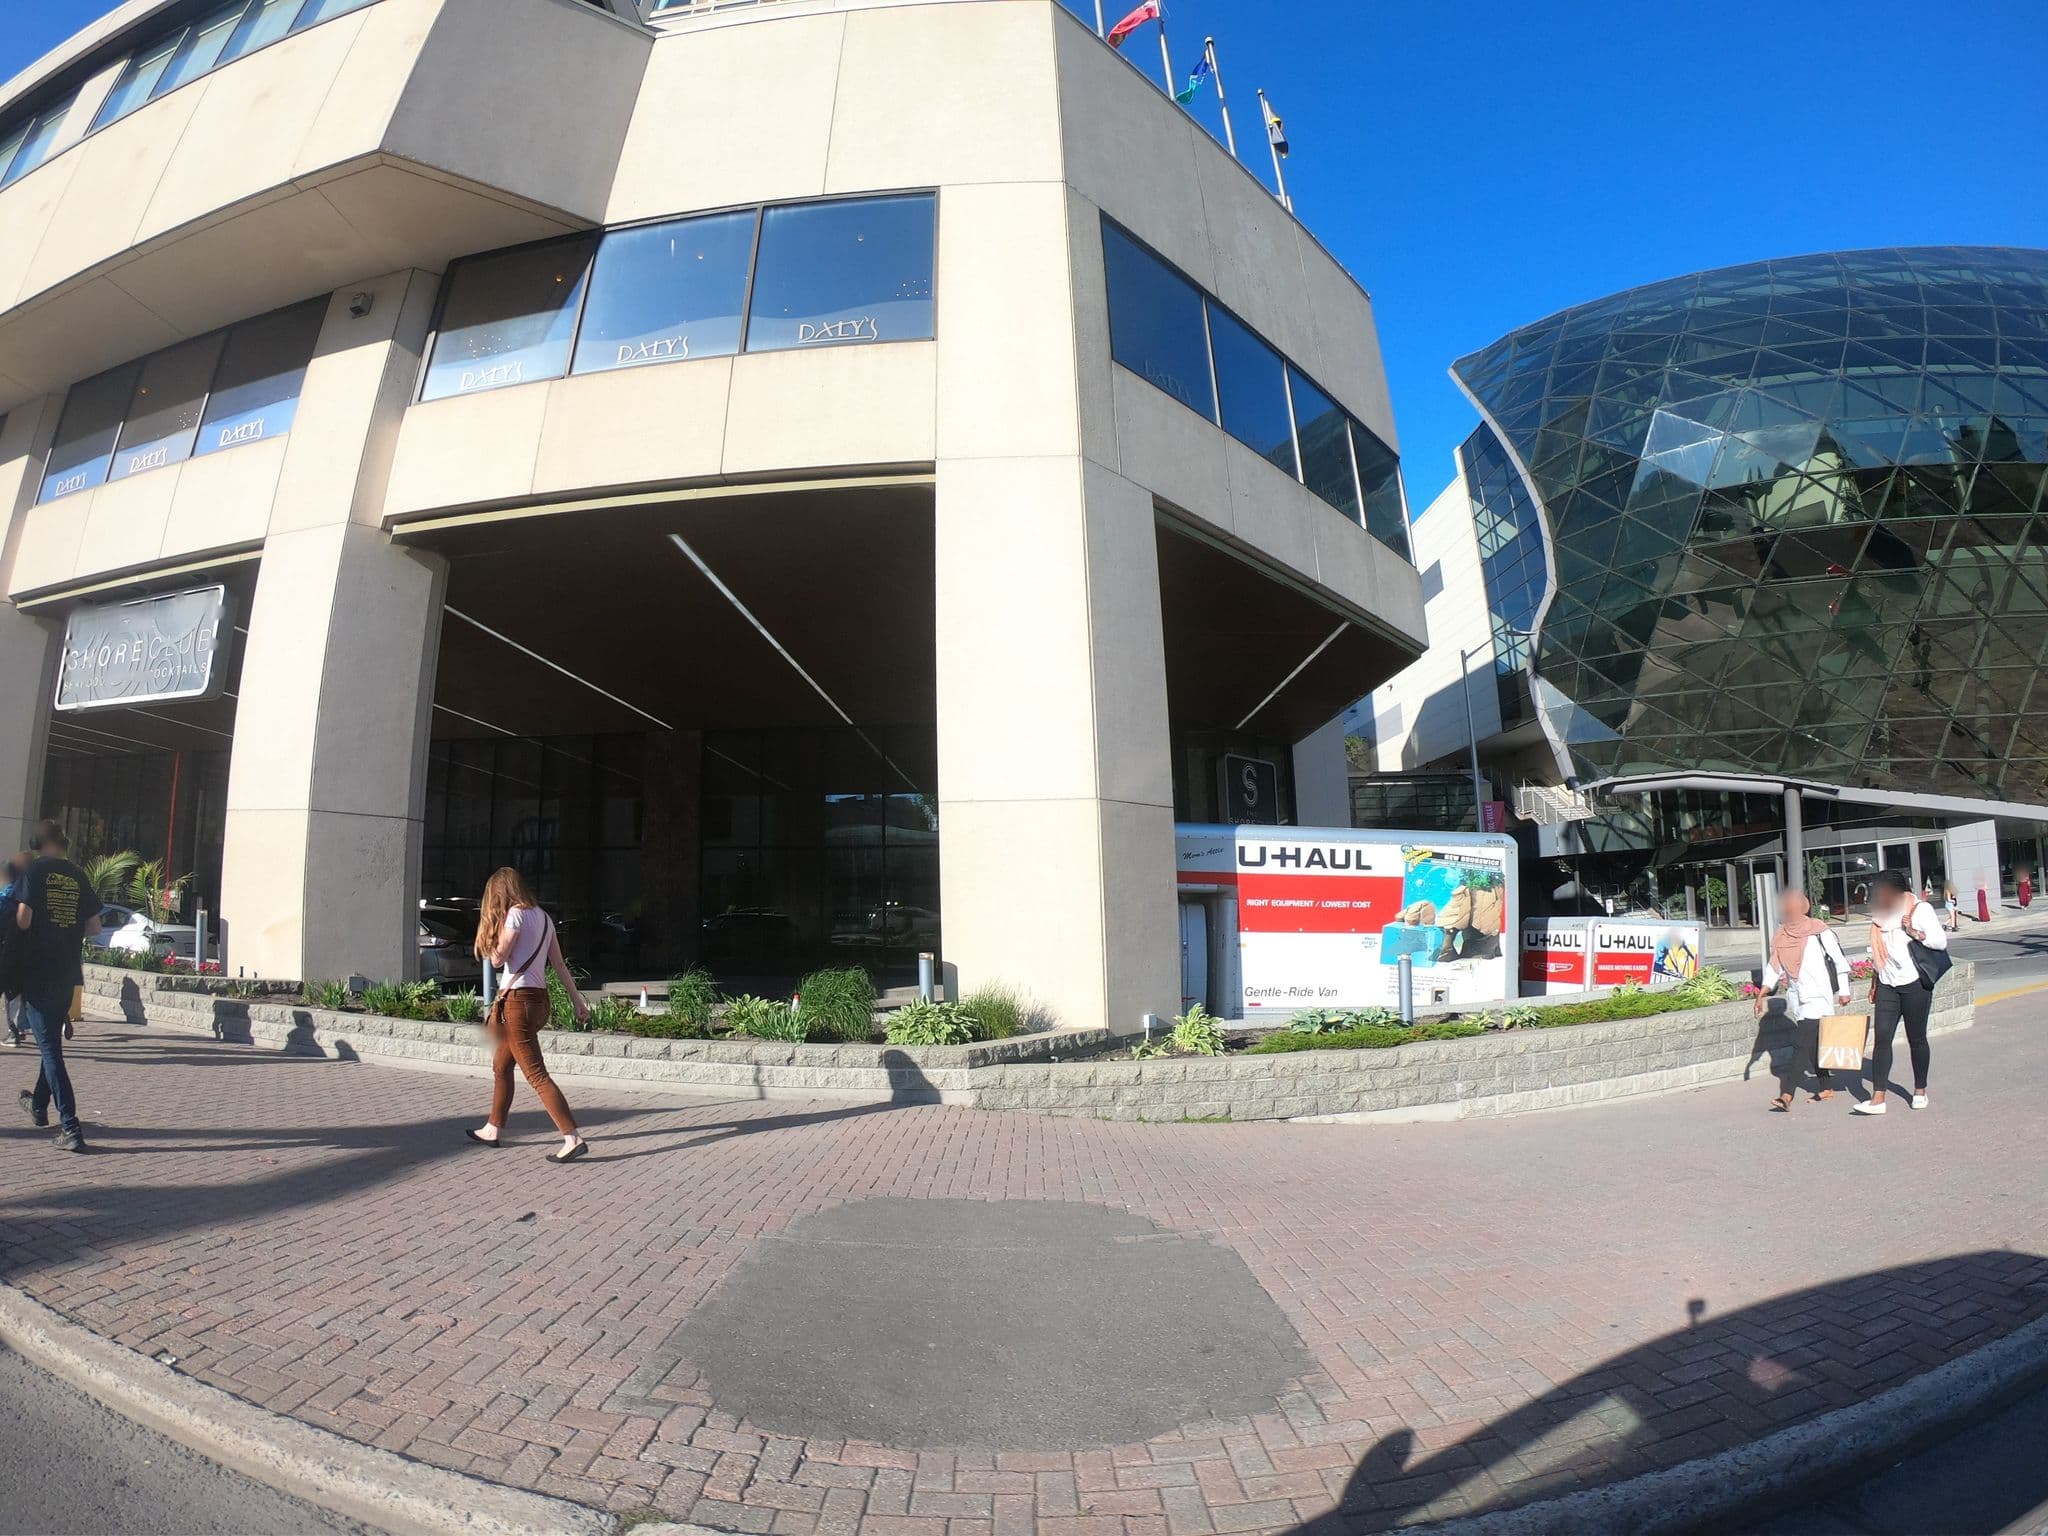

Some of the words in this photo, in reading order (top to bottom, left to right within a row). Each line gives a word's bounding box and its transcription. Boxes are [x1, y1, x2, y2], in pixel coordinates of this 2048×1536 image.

[798, 316, 878, 344] DALY'S
[616, 335, 689, 367] DALY'S
[460, 360, 523, 391] DALY'S
[219, 417, 264, 446] DALY'S
[150, 662, 207, 679] OCKTAILS
[1238, 845, 1372, 871] U-HAUL
[1246, 898, 1269, 907] RIGHT
[1271, 899, 1314, 908] EQUIPMENT
[1321, 900, 1350, 909] LOWEST
[1352, 900, 1372, 909] COST
[1527, 933, 1582, 948] U-HAUL
[1599, 934, 1654, 950] U-HAUL
[1244, 986, 1314, 998] Gentle-Ride
[1318, 986, 1338, 997] Van
